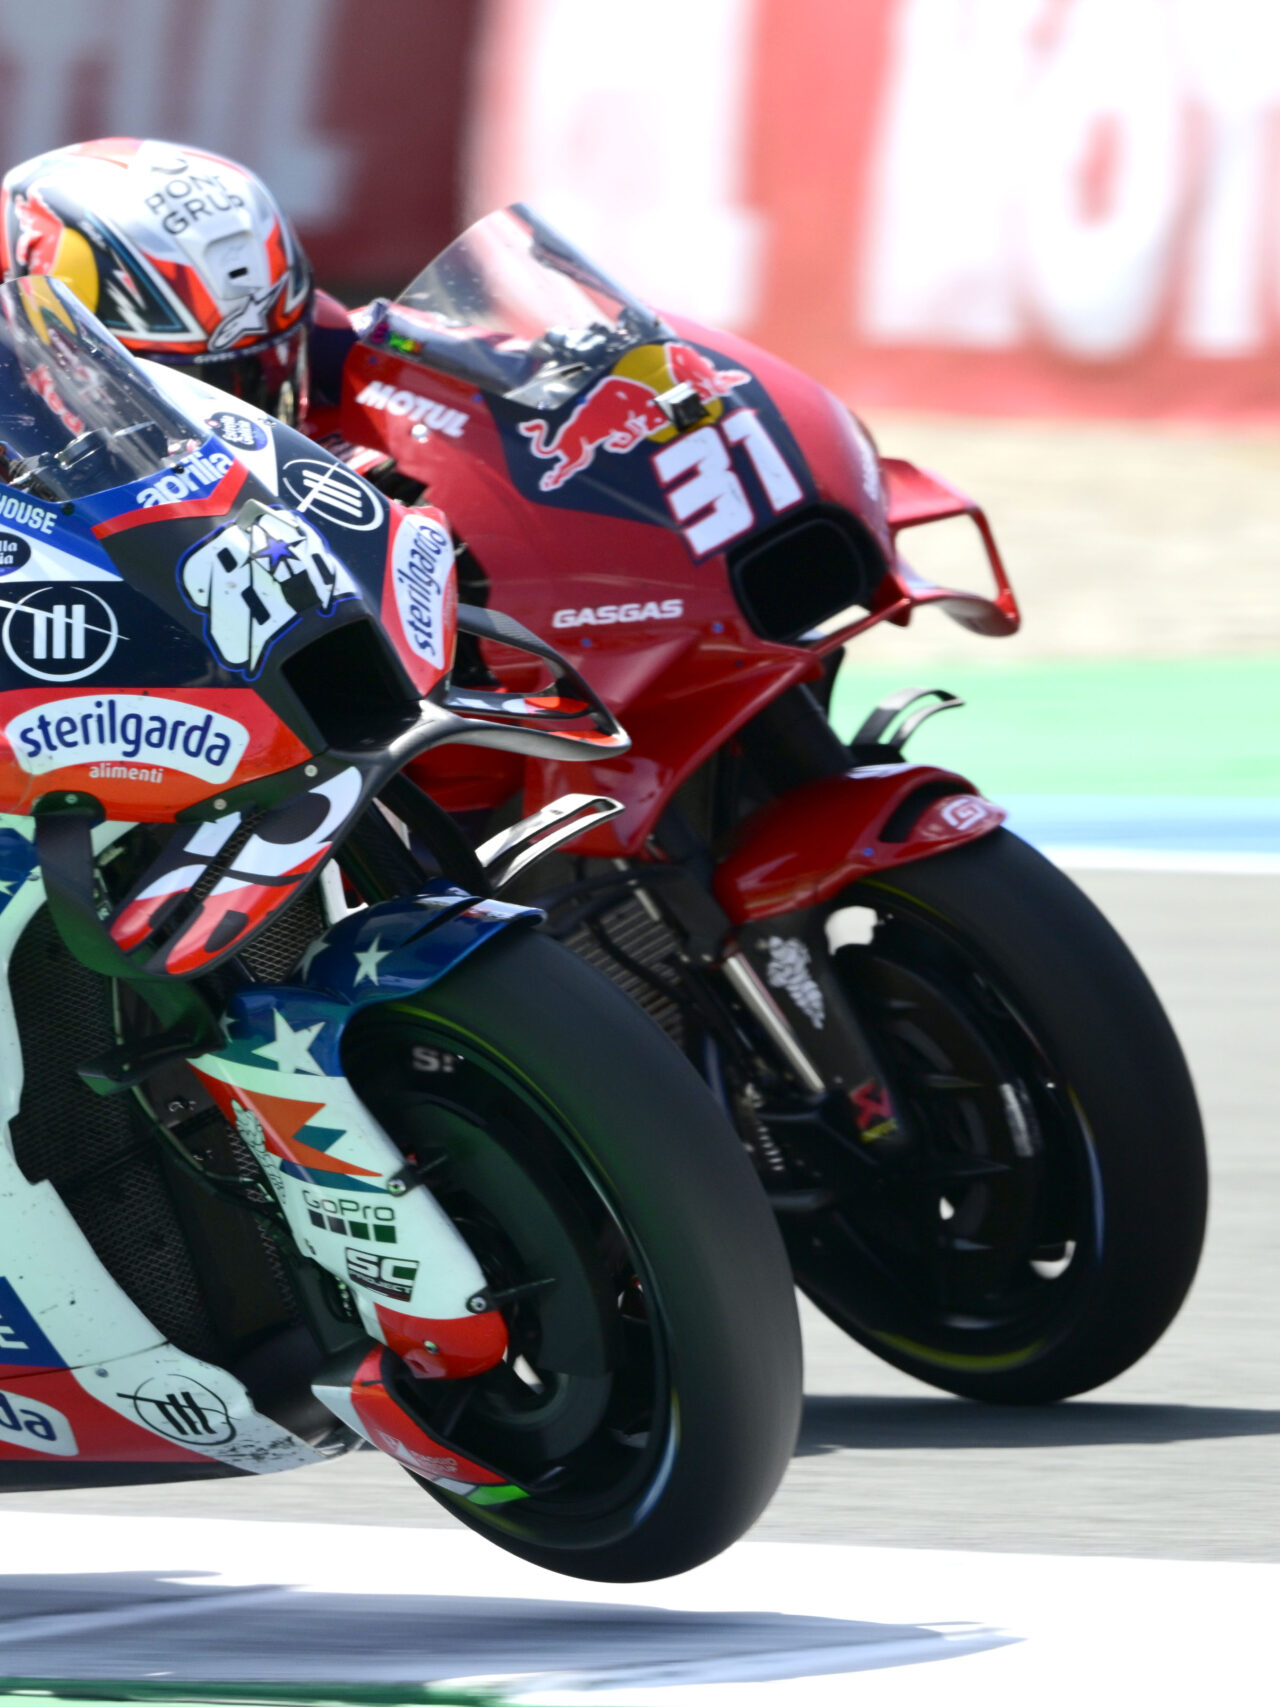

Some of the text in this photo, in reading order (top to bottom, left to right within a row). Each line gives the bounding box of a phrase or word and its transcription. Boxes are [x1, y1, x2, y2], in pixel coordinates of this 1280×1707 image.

[356, 380, 470, 438] MOTUL
[136, 451, 234, 508] aprilia
[652, 409, 804, 556] 31
[552, 598, 684, 628] GASGAS
[20, 699, 231, 767] sterilgarda
[89, 762, 164, 784] alimenti
[302, 1190, 395, 1222] GoPro
[346, 1248, 418, 1287] SC
